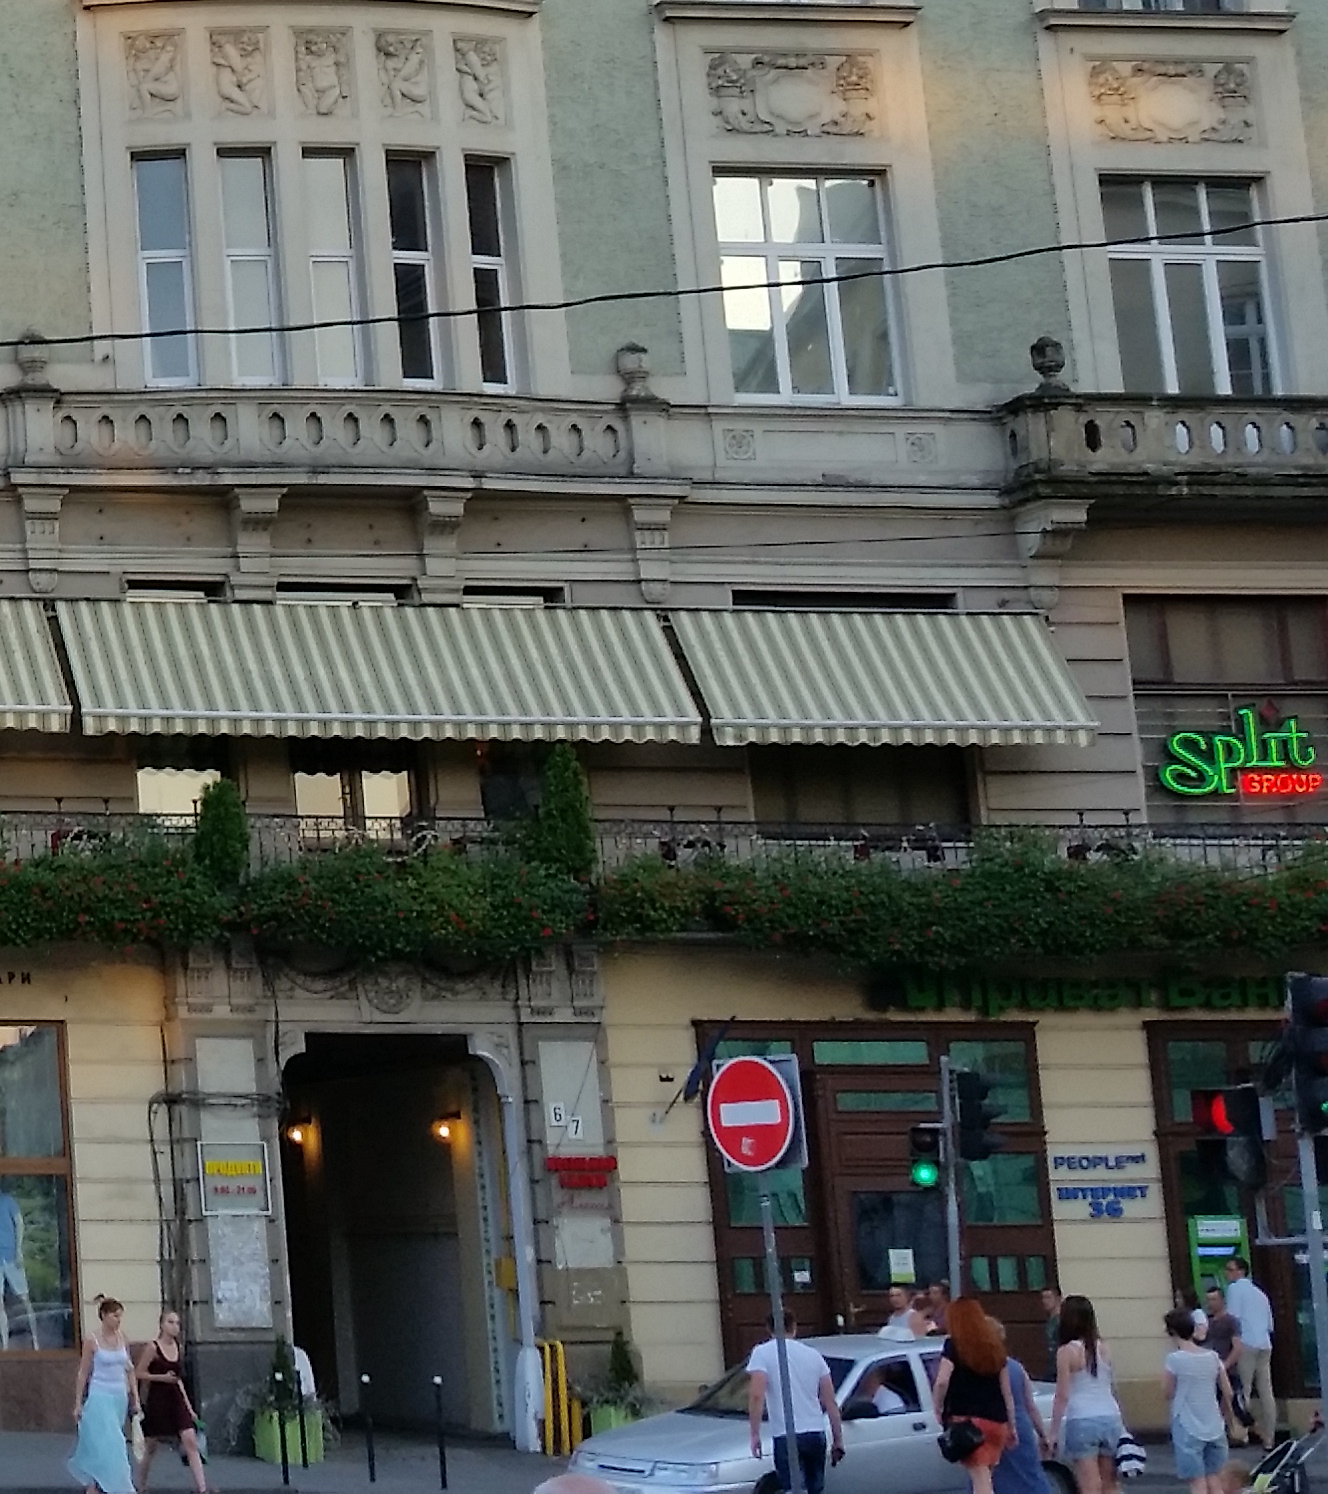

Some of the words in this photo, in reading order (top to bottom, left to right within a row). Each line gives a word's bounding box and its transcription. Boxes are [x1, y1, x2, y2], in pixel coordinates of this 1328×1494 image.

[1161, 706, 1316, 794] Split
[1245, 772, 1322, 794] GROUP
[553, 1106, 562, 1123] 6
[571, 1119, 580, 1136] 7
[1089, 1200, 1123, 1218] 3G
